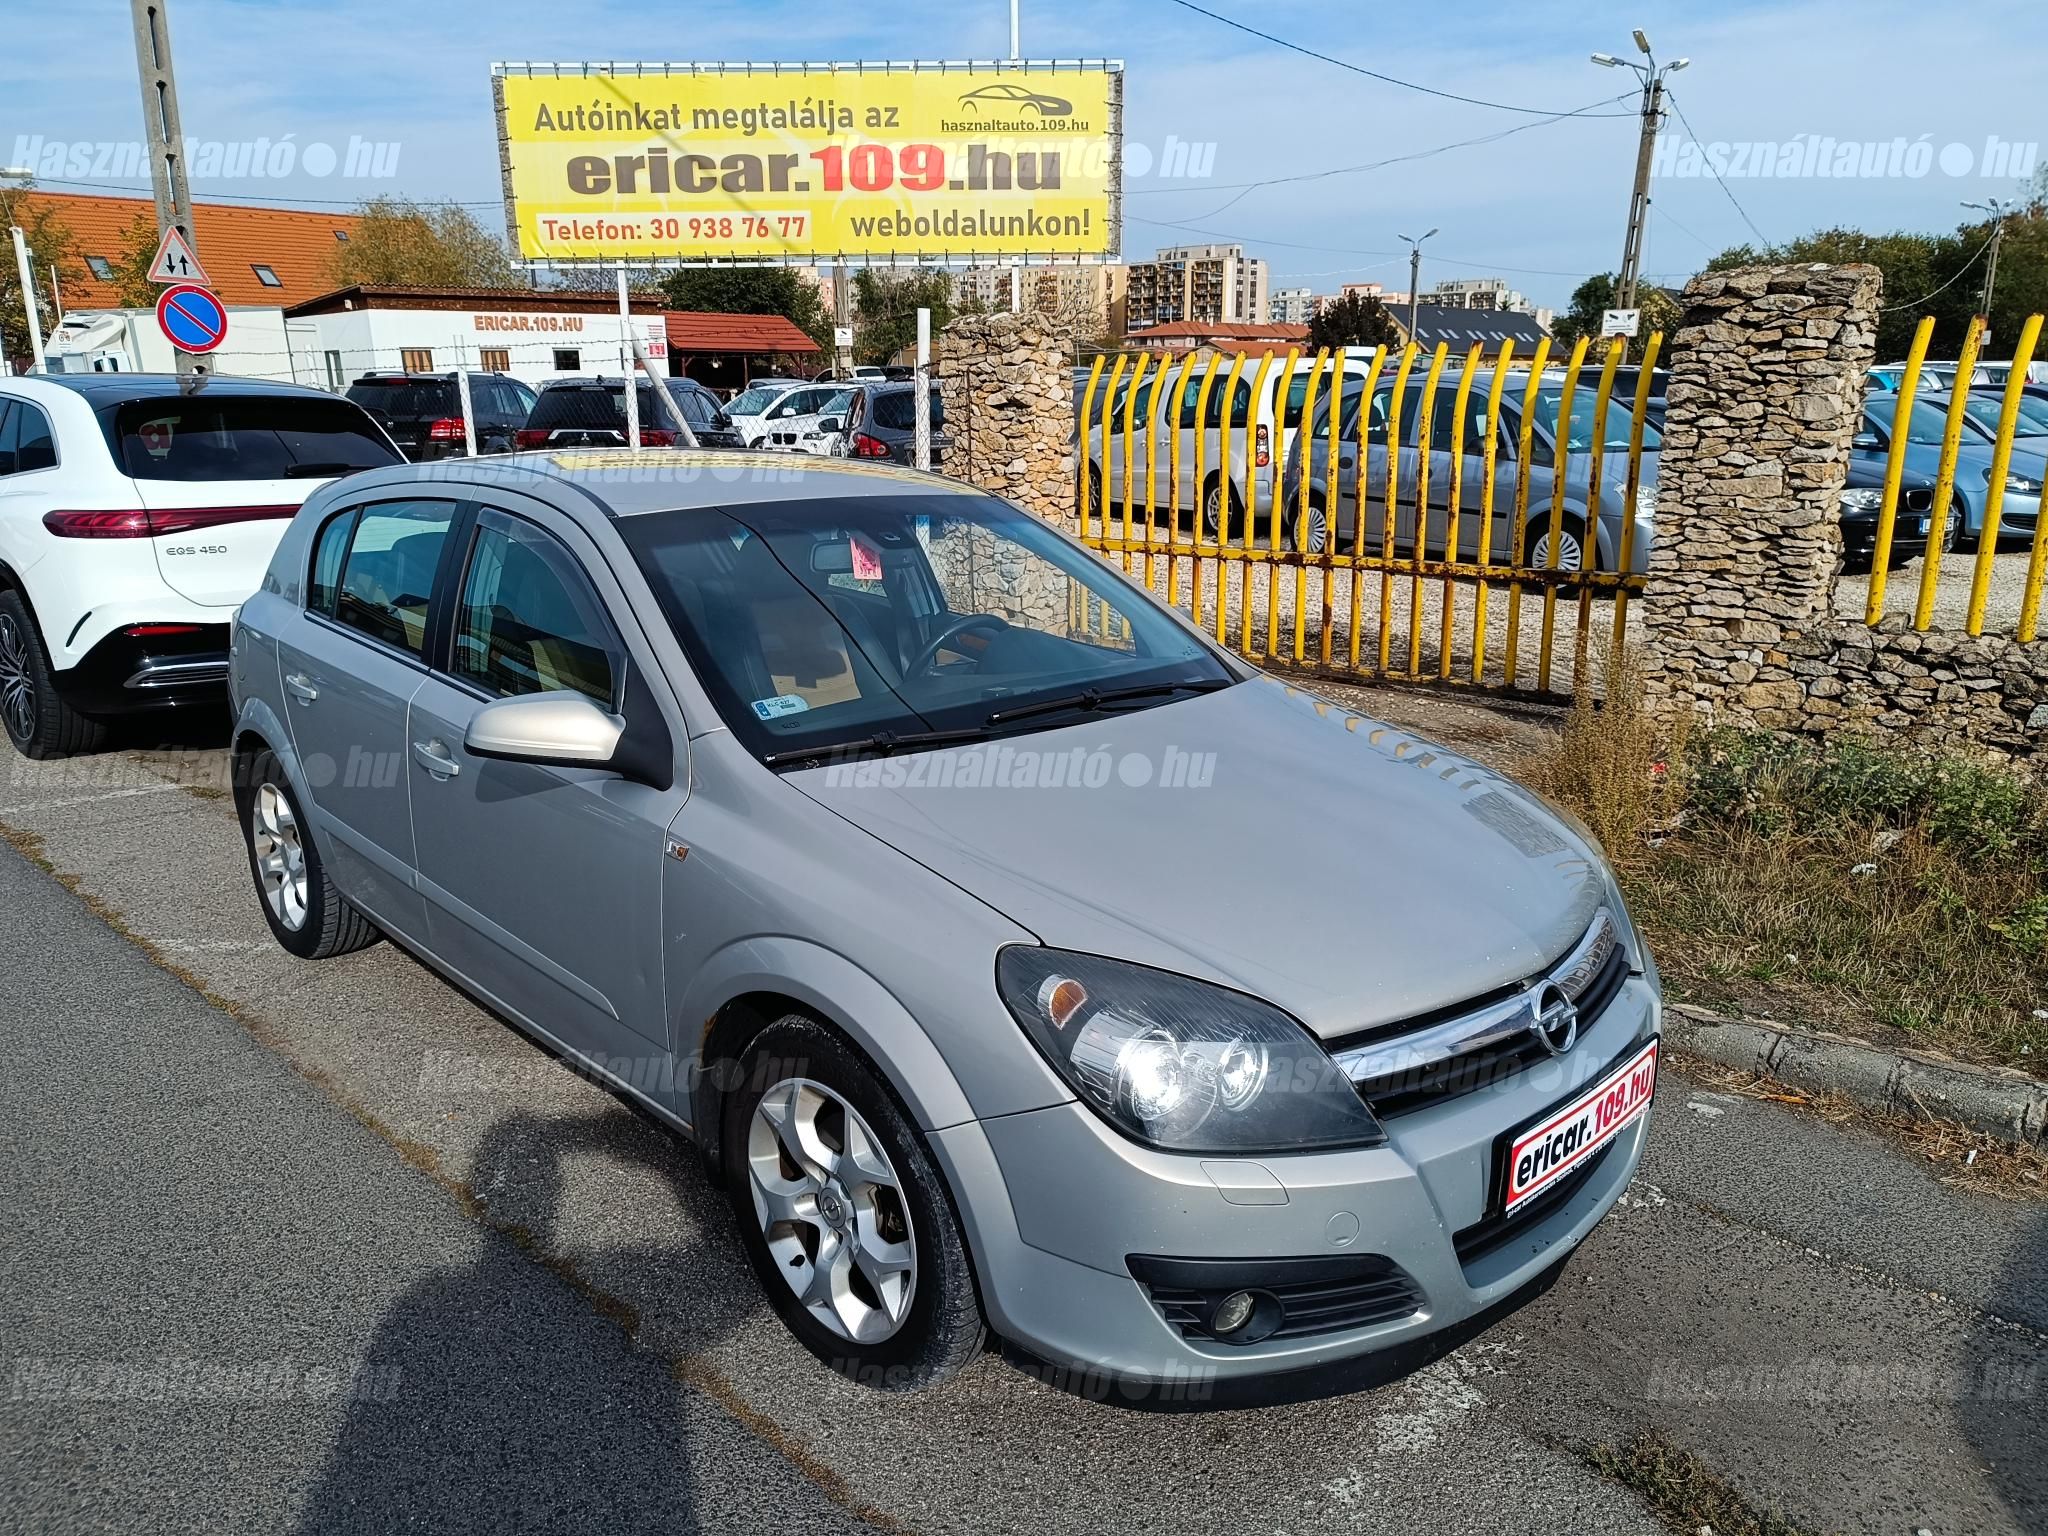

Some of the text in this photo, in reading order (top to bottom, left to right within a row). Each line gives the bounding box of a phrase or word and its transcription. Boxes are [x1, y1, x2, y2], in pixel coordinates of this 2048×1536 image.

[534, 96, 900, 137] Autóinkat megtalálja az
[940, 117, 1090, 134] hasznaltauto.109.hu
[567, 146, 1061, 195] ericar.109.hu
[542, 217, 805, 241] Telefon: 30 938 76 77
[850, 207, 1091, 239] weboldalunkon!
[474, 315, 583, 332] ERICAR.109.HU
[166, 545, 228, 556] EQS 450
[1517, 1063, 1652, 1188] ericar.109.hu
